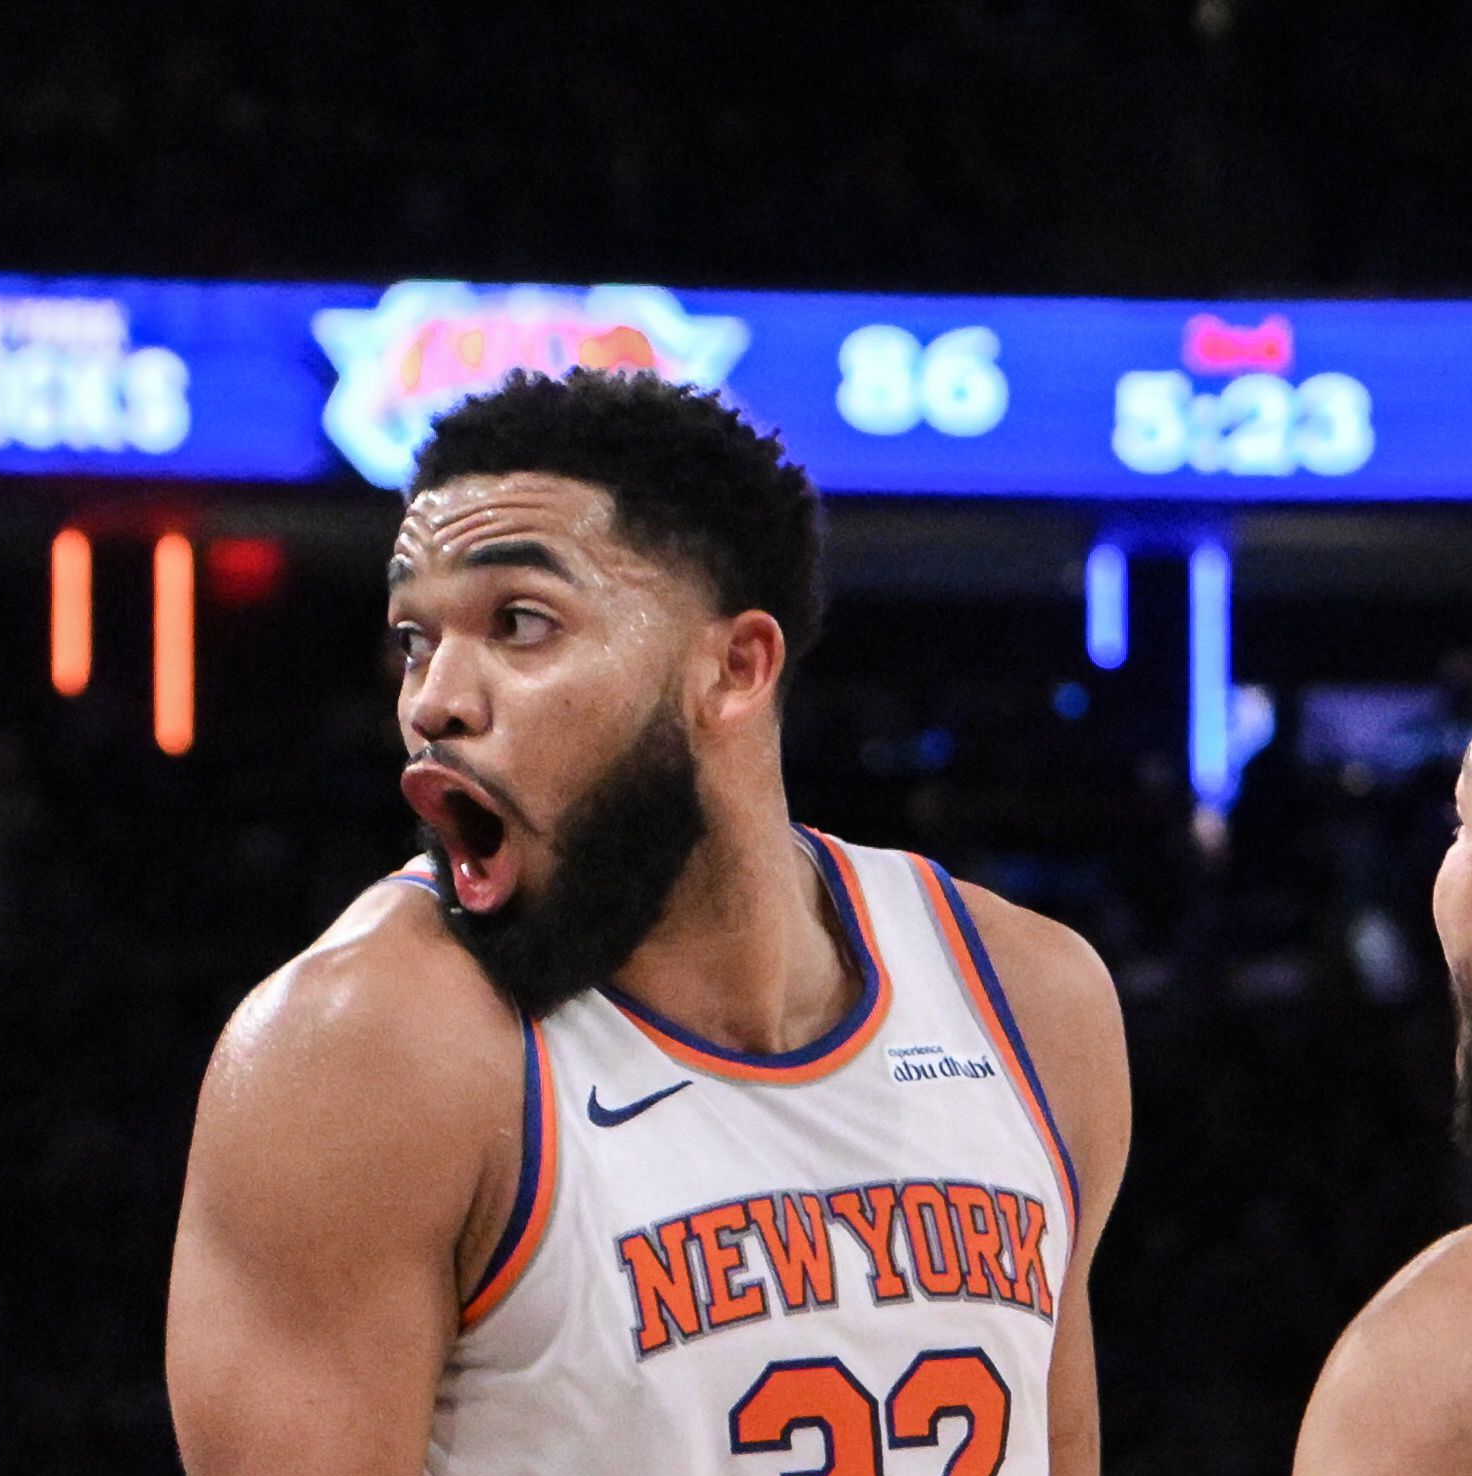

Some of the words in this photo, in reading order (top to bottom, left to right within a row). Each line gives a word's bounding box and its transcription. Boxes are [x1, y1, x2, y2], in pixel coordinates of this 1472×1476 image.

[837, 325, 1006, 434] 86
[1113, 368, 1374, 474] 5:23
[894, 1060, 937, 1082] abu
[939, 1055, 996, 1079] dhabi
[616, 1190, 838, 1361] NEW
[828, 1178, 1055, 1325] YORK
